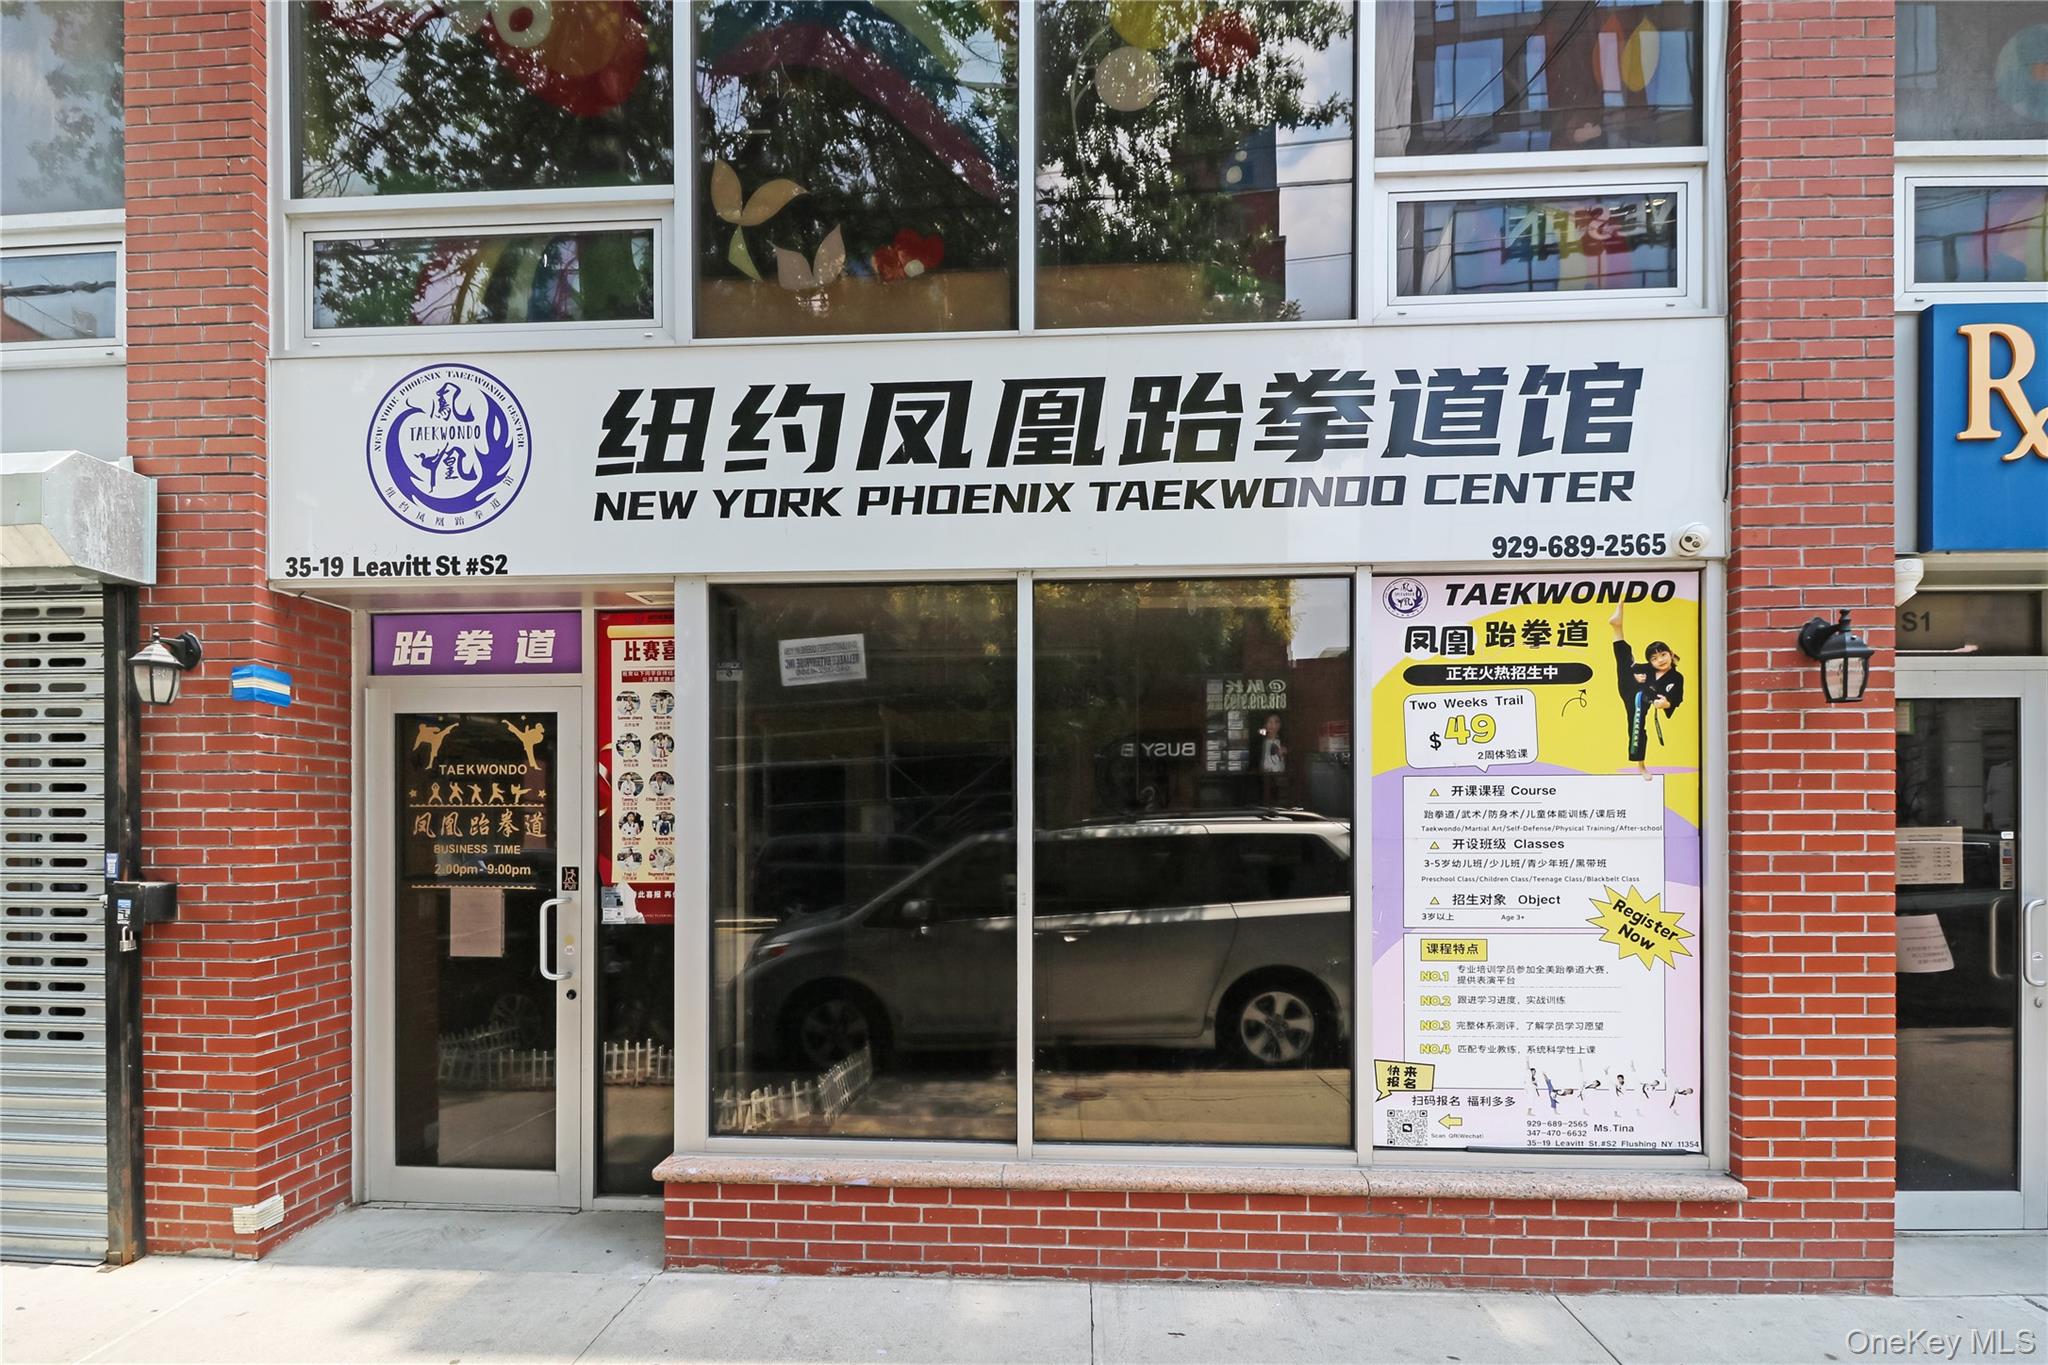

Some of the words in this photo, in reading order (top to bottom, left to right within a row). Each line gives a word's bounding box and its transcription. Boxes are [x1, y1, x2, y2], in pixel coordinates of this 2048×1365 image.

[400, 371, 441, 396] PHOENIX
[446, 370, 506, 402] TAEKWONDO
[508, 404, 524, 448] CENTER
[594, 361, 1644, 476] 纽约凤凰跆拳道馆
[410, 425, 481, 442] TAEKWONDO
[594, 490, 698, 521] NEW
[712, 486, 844, 519] YORK
[856, 482, 1072, 516] PHOENIX
[1089, 475, 1406, 513] TAEKWONDO
[1424, 470, 1636, 506] CENTER
[1492, 532, 1666, 558] 929-689-2565
[285, 556, 344, 578] 35-19
[352, 554, 432, 578] Leavitt
[436, 555, 461, 576] St
[466, 554, 508, 576] #S2
[1445, 580, 1676, 606] TAEKWONDO
[1902, 611, 1932, 632] S1
[1404, 625, 1476, 656] 凤凰
[1485, 619, 1590, 648] 跆拳道
[392, 628, 556, 666] 跆拳道
[1446, 664, 1559, 681] 正在火热招生中
[1410, 699, 1437, 710] Two
[1444, 697, 1488, 709] Weeks
[1496, 695, 1524, 706] Trail
[1477, 748, 1528, 760] 2周体验课
[438, 764, 528, 776] TAEKWONDO
[1451, 784, 1506, 798] 开课课程
[1511, 785, 1557, 796] Course
[412, 808, 548, 838] 凤凰跆拳道
[1587, 824, 1662, 833] Training/After-school
[434, 844, 488, 854] BUSINESS
[494, 844, 521, 854] TIME
[1452, 838, 1506, 850] 开设班级
[1514, 840, 1565, 850] Classes
[487, 864, 532, 878] 9:00pm
[1510, 876, 1563, 884] Class/Teenage
[1452, 893, 1506, 906] 招生对象
[1518, 894, 1561, 907] Object
[1422, 912, 1455, 922] 3岁以上
[1501, 914, 1514, 922] Age
[1611, 898, 1680, 942] Register
[1617, 924, 1656, 950] Now
[1426, 944, 1479, 955] 课程特点
[1420, 970, 1450, 982] NO.1
[1456, 976, 1516, 985] 提供表演平台
[1420, 996, 1452, 1006] NO.2
[1420, 1020, 1452, 1031] NO.3
[1420, 1044, 1452, 1055] NO.4
[1386, 1064, 1418, 1077] 快来
[1386, 1076, 1417, 1090] 报名
[1412, 1096, 1460, 1107] 扫码报名
[1468, 1096, 1516, 1108] 福利多多
[1526, 1120, 1588, 1128] 929-689-2565
[1594, 1124, 1635, 1132] Ms.Tina
[1621, 1140, 1657, 1148] Flushing
